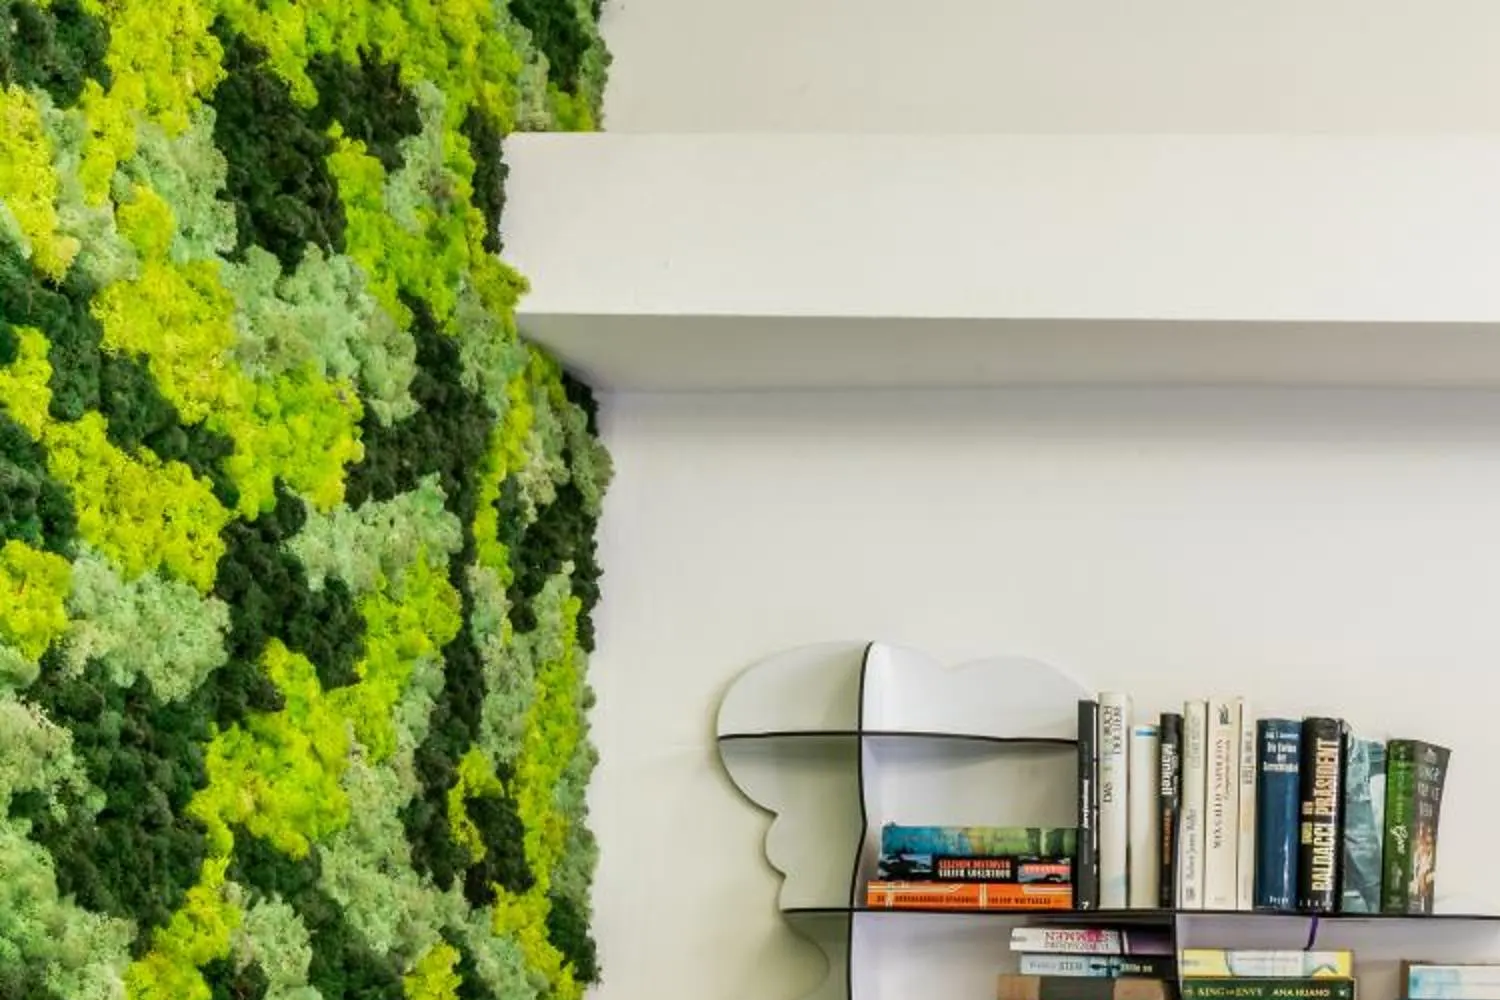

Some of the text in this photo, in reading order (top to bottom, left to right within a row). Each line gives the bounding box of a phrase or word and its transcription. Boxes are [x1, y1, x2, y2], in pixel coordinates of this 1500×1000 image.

[1161, 743, 1176, 796] Mankell
[1312, 737, 1338, 816] PRÄSIDENT
[1311, 823, 1335, 891] BALDACCI
